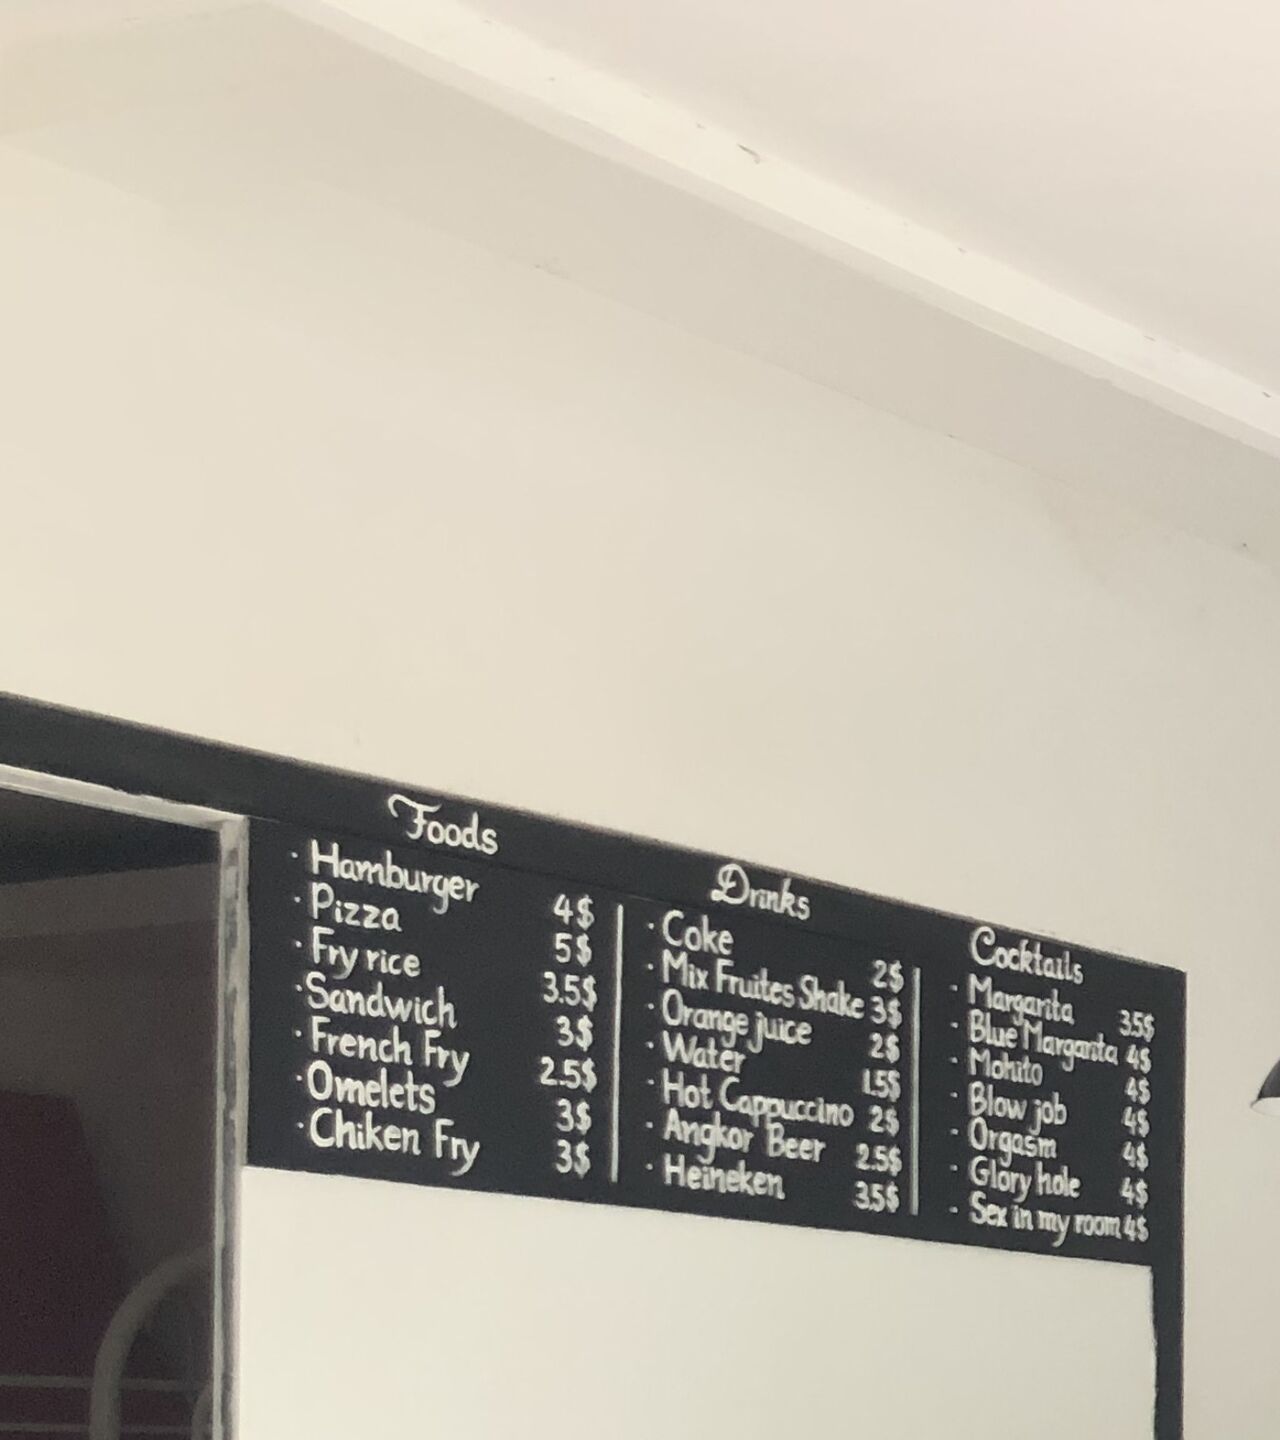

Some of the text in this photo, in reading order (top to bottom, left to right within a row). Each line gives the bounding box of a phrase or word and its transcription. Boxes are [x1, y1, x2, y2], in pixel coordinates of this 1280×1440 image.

[388, 793, 499, 855] Foods
[310, 839, 594, 930] Hamburger 4$
[711, 863, 810, 920] Drinks
[310, 882, 592, 967] Pizza 5$
[311, 926, 358, 979] Fry
[367, 947, 420, 977] rice
[662, 910, 903, 993] Coke 2$
[969, 926, 1084, 985] Cocktails
[305, 971, 593, 1052] Sandwich 3$
[662, 949, 902, 1029] Mix Fruites Shake 3$
[968, 973, 1075, 1025] Margarita
[311, 1016, 598, 1093] French Fry 2.5$
[661, 1030, 746, 1073] Water
[662, 988, 900, 1063] Orange juice 2$
[969, 1009, 1151, 1073] Blue Margarita 4$
[306, 1060, 592, 1135] Omelets 3$
[661, 1068, 899, 1137] Hot Cappuccino 2$
[968, 1082, 1149, 1137] Blow job 4$
[1125, 1077, 1150, 1105] 4$
[310, 1107, 591, 1179] Chiken Fry 3$
[663, 1107, 902, 1177] Angkor Beer 2.5$
[968, 1117, 1149, 1171] Orgasm 4$
[663, 1153, 785, 1199] Heineken
[969, 1156, 1149, 1209] Glory hole 4$
[969, 1190, 1149, 1247] Sex in my room 4$
